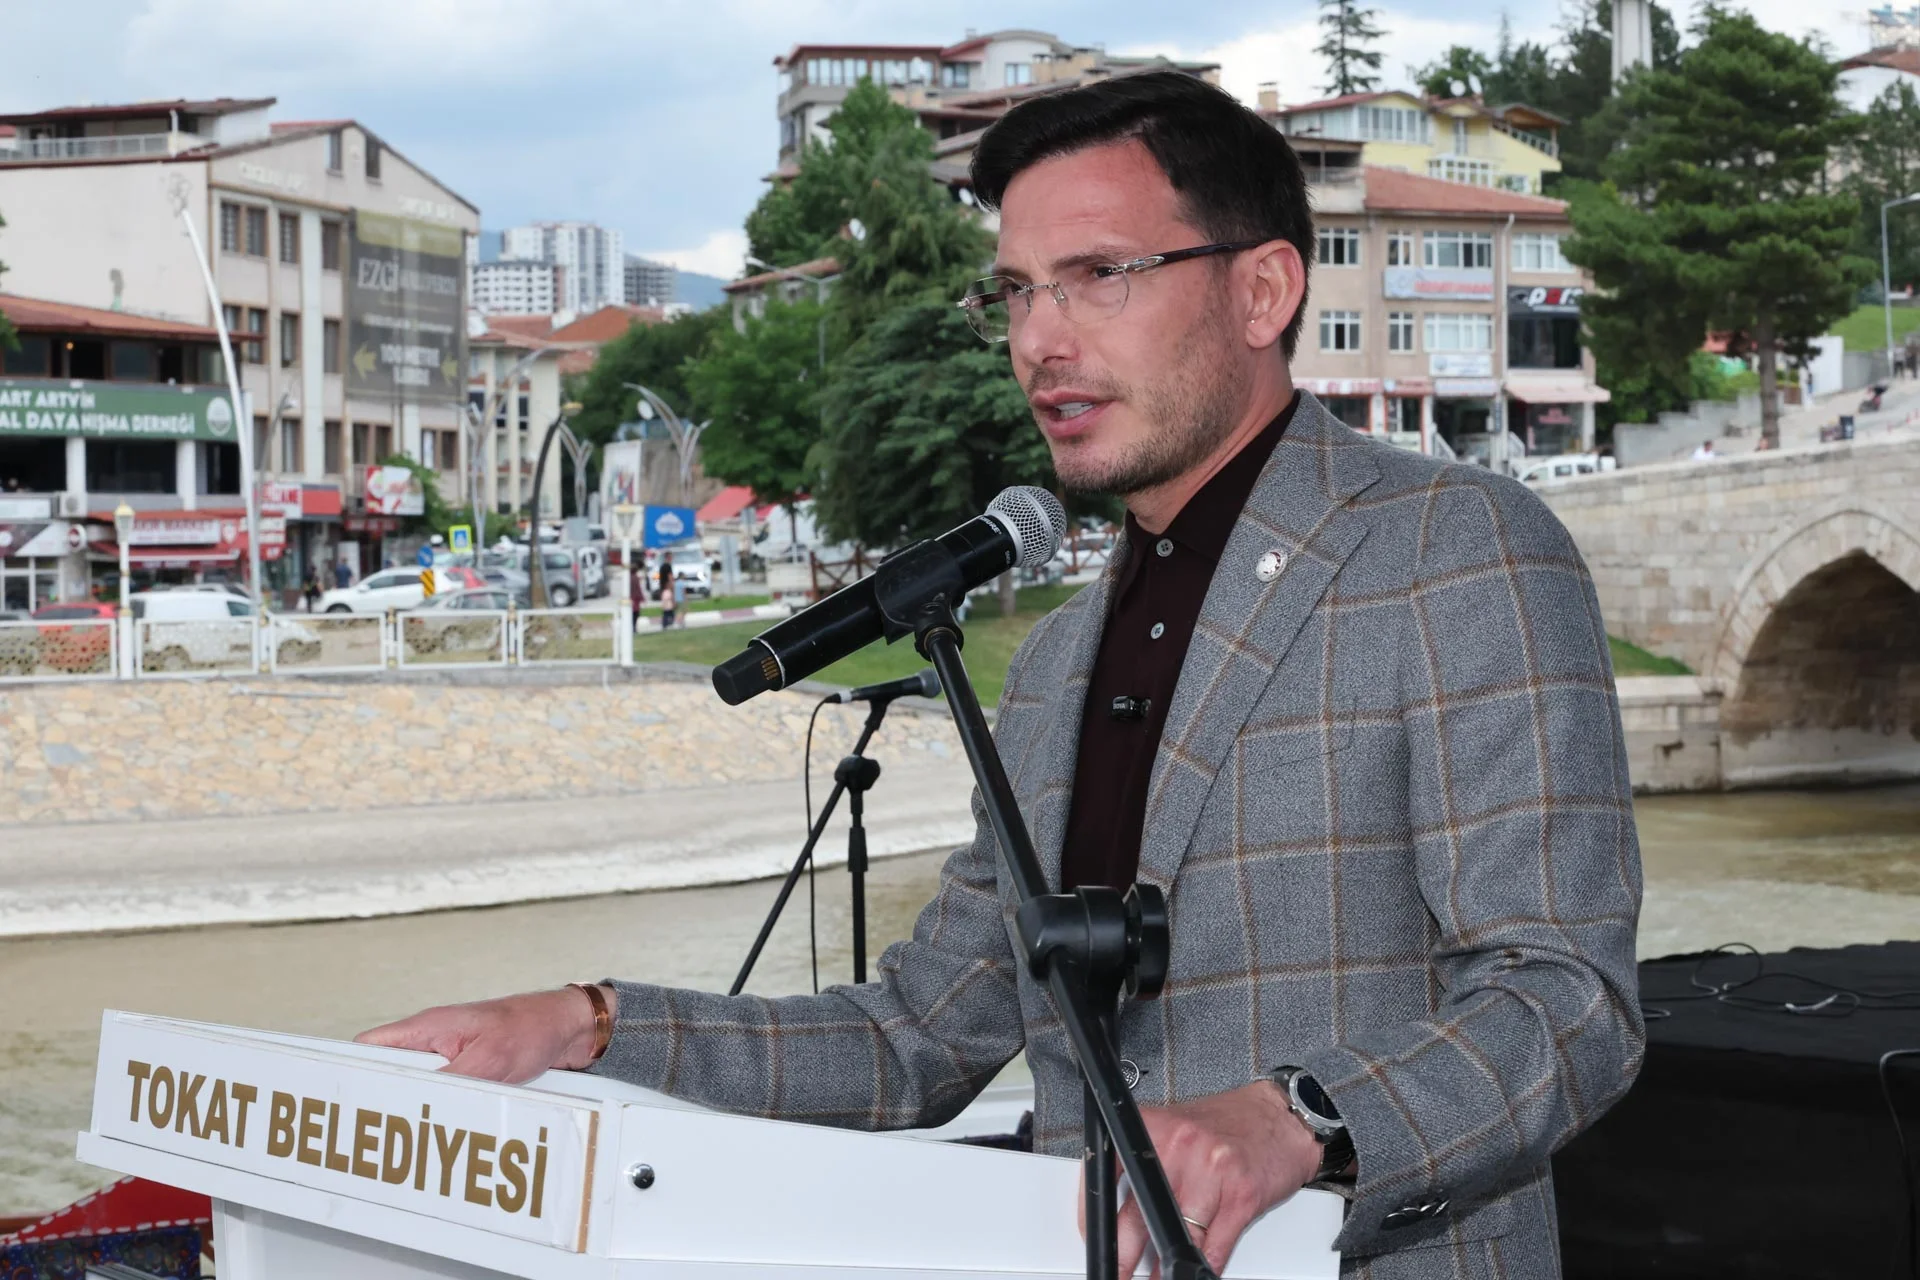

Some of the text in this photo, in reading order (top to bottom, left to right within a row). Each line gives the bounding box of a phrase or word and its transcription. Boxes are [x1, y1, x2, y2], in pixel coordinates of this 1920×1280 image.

[35, 389, 96, 409] ARTVİN
[25, 410, 129, 436] DAYANIŞMA
[131, 412, 196, 434] DERNEĞİ
[127, 1059, 549, 1219] TOKAT BELEDİYESİ
